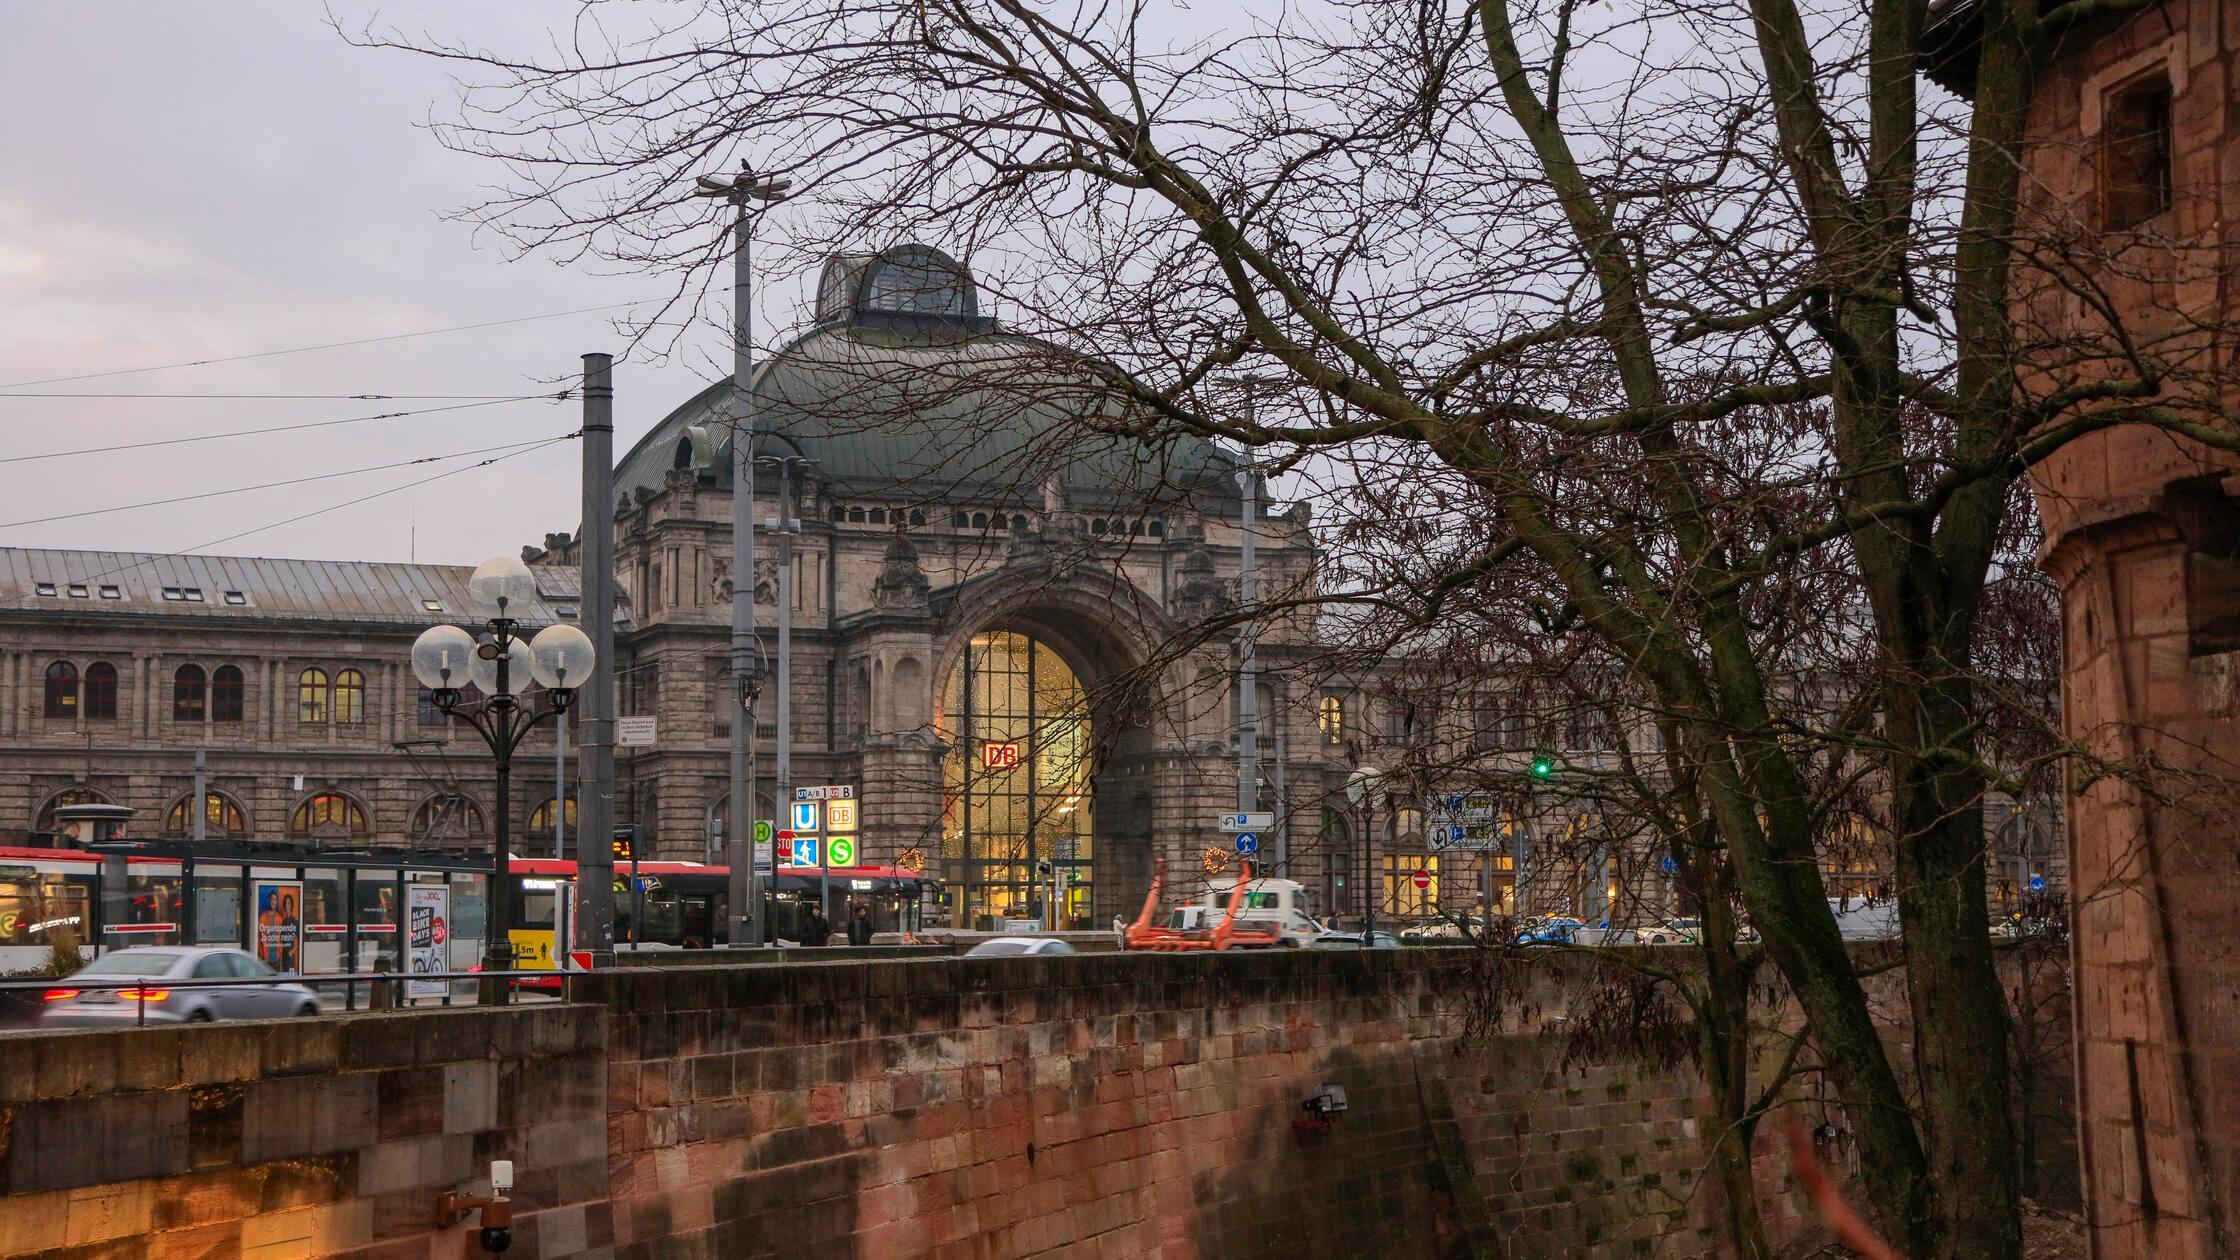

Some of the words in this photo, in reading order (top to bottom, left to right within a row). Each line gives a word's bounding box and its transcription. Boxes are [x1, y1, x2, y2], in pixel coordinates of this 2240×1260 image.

[989, 747, 1016, 765] DB
[844, 786, 850, 798] B
[796, 806, 814, 829] U
[832, 810, 850, 822] DB
[777, 838, 790, 849] STO
[834, 842, 848, 861] S
[413, 908, 430, 920] BLACK
[413, 917, 430, 931] BIKE
[413, 929, 430, 941] DAYS
